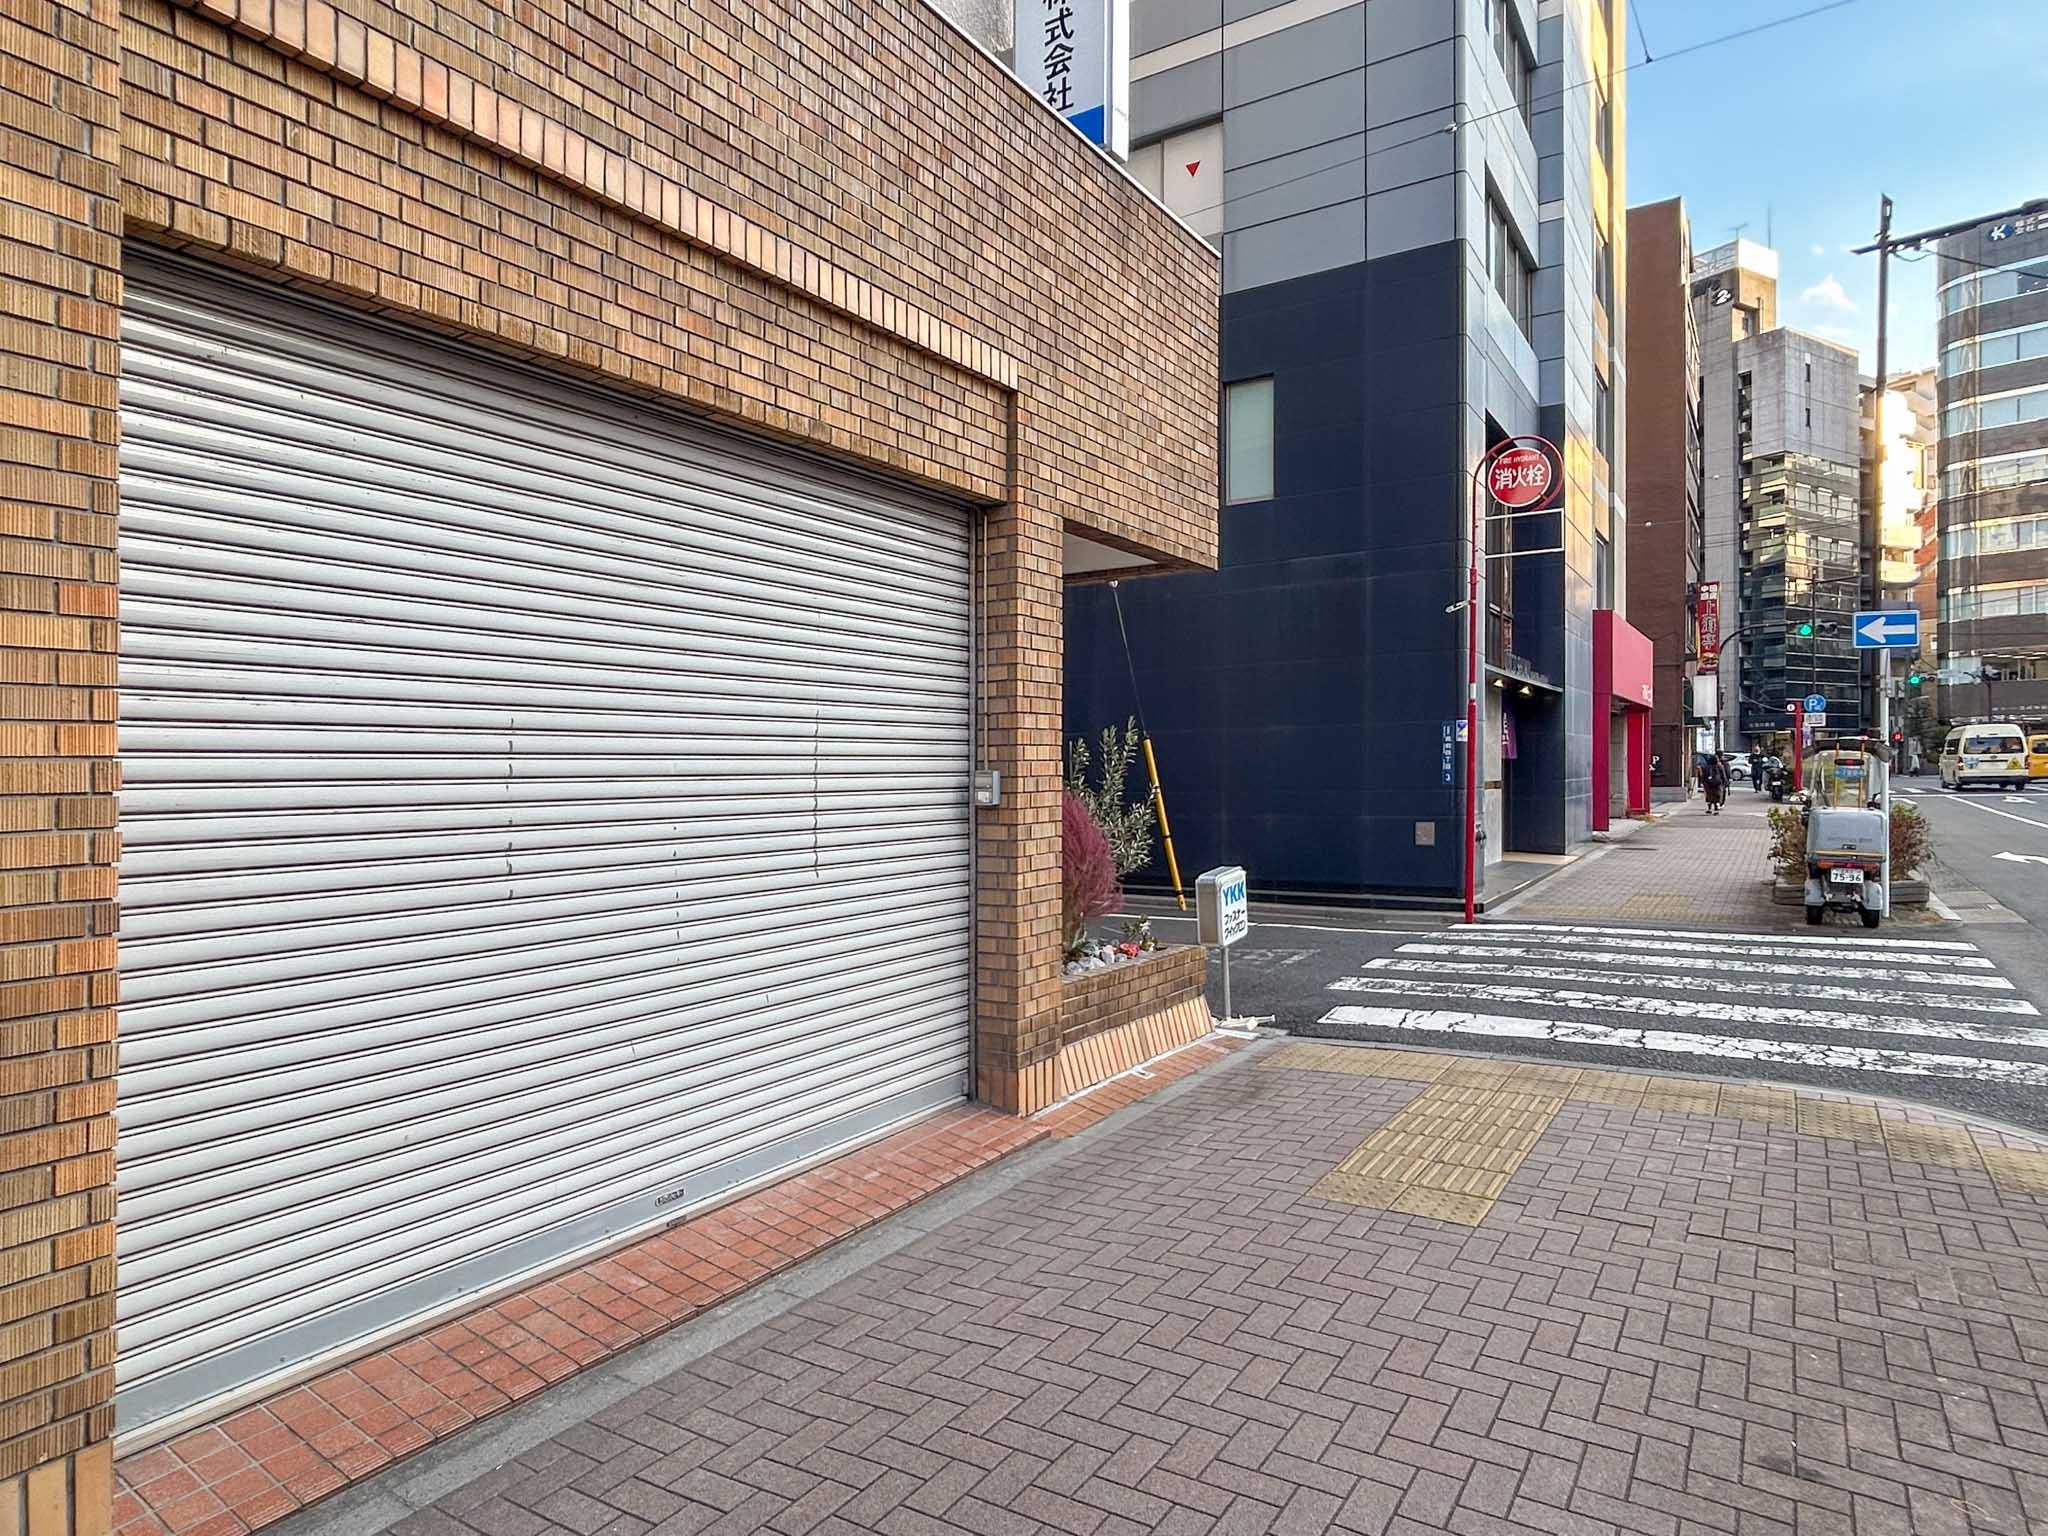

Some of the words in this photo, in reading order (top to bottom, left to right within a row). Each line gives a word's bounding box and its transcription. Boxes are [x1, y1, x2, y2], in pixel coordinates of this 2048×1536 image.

[1495, 463, 1545, 490] 消火栓
[1809, 699, 1817, 711] P
[1223, 880, 1245, 906] YKK
